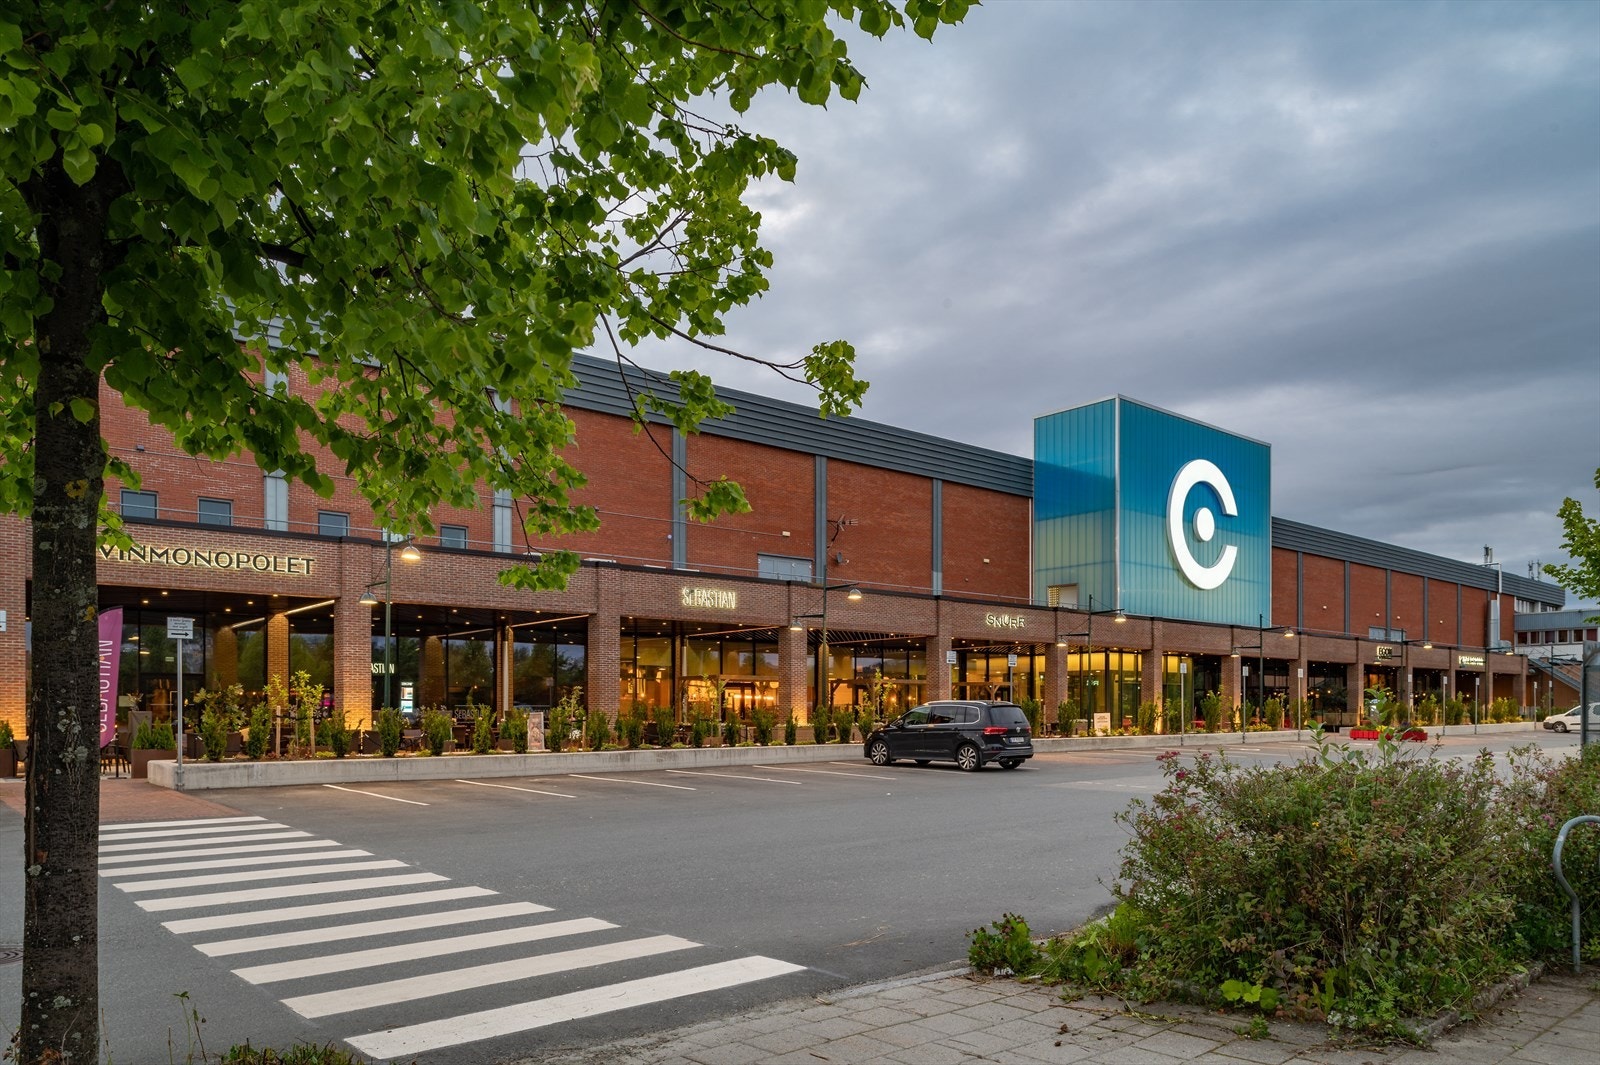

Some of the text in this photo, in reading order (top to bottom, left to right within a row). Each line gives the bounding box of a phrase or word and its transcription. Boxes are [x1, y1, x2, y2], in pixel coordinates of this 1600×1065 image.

[98, 545, 315, 575] VINMONOPOLET
[682, 586, 736, 609] SEBASTIAN
[986, 613, 1026, 629] SNURR
